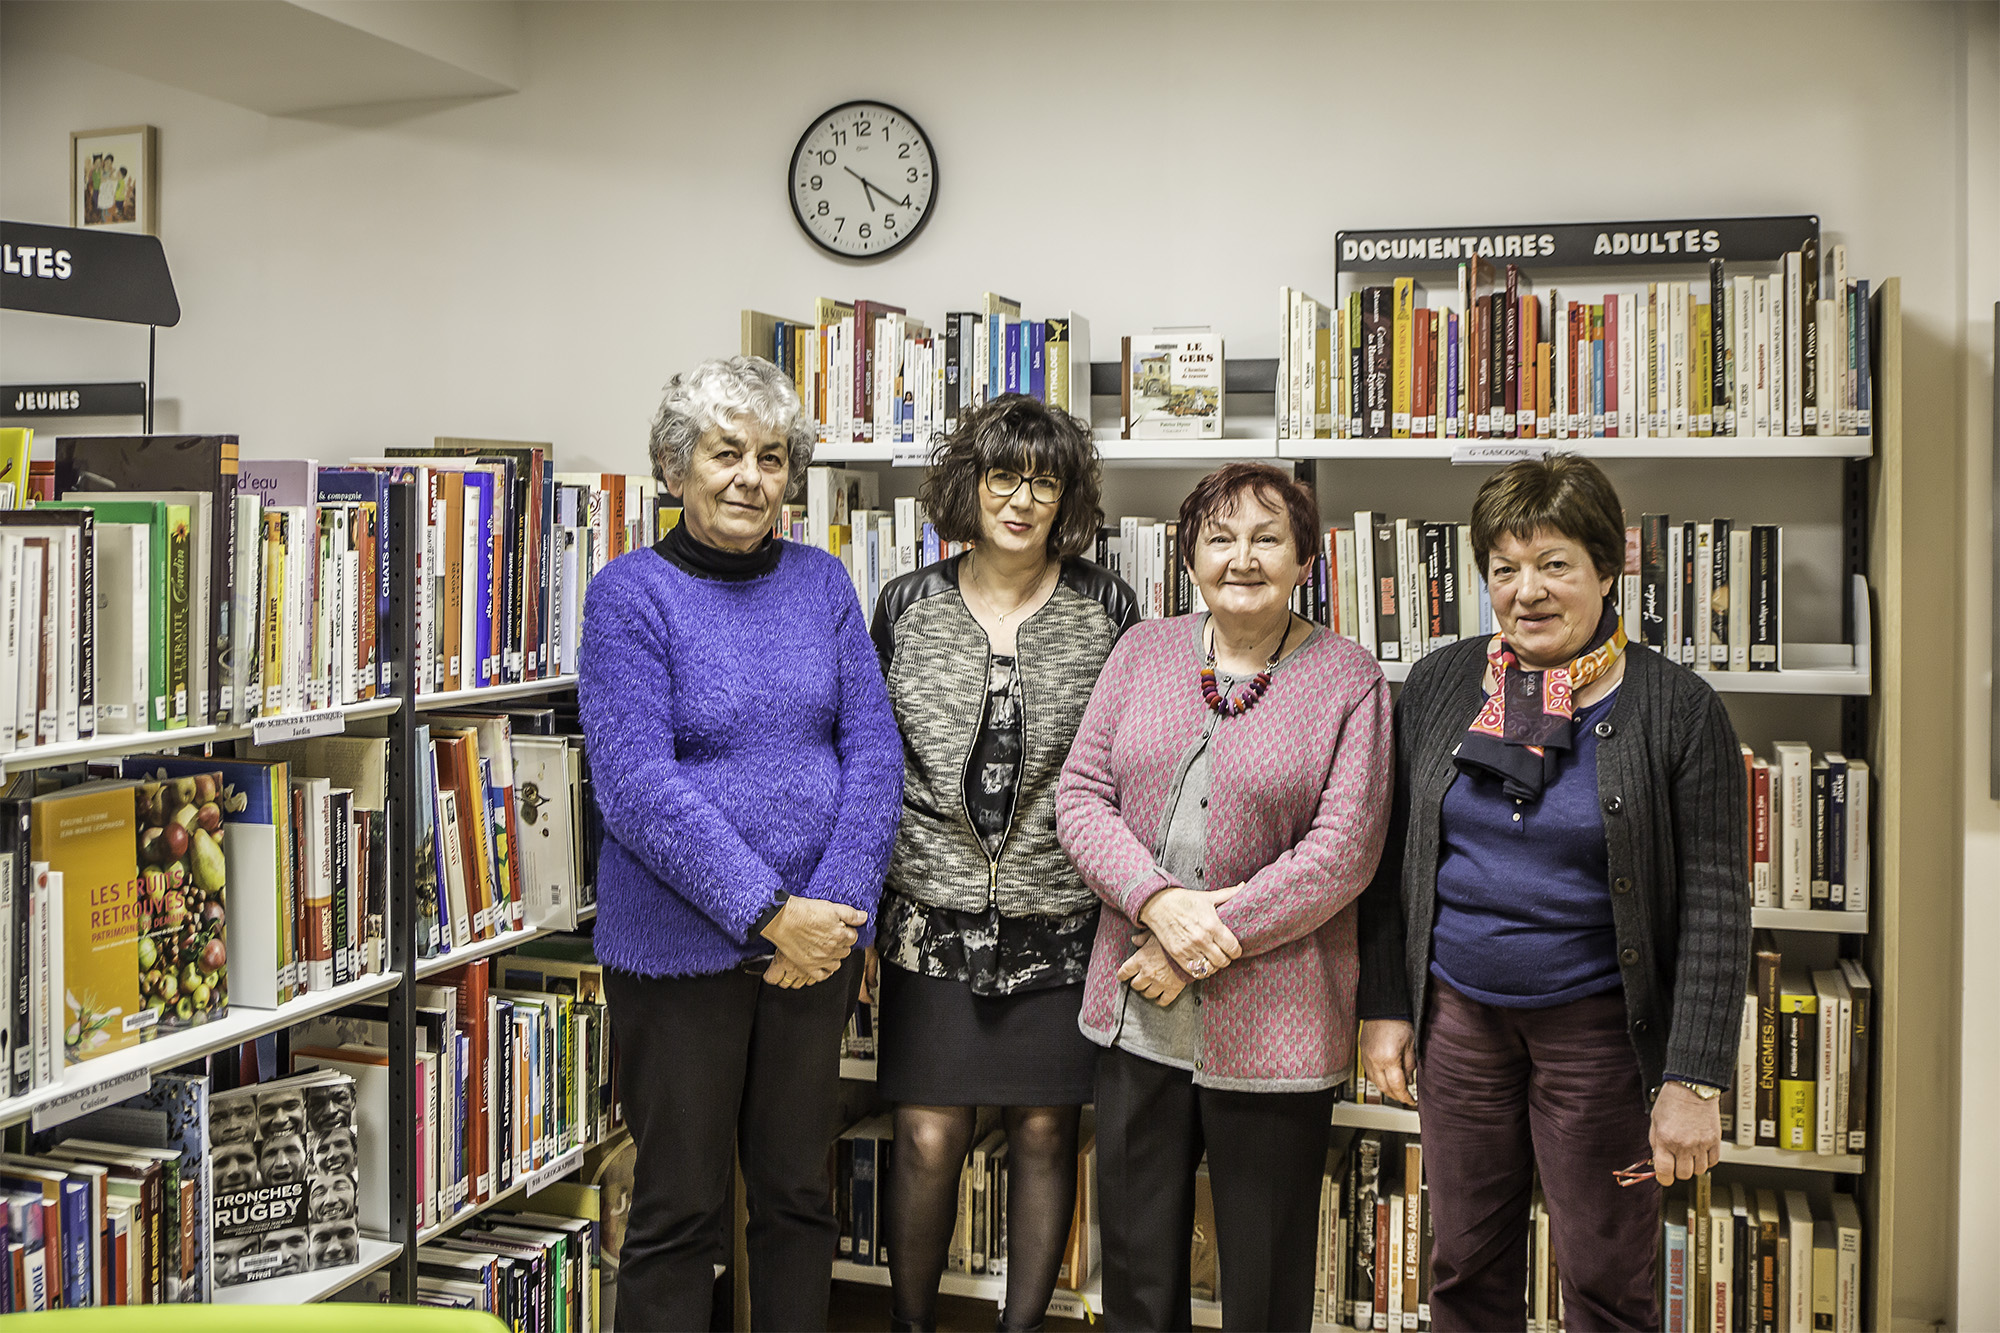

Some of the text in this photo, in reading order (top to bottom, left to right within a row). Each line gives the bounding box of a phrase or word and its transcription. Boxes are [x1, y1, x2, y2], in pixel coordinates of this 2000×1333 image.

[832, 131, 846, 146] 11
[852, 121, 871, 137] 12
[882, 126, 889, 141] 1
[816, 150, 837, 166] 10
[898, 143, 910, 159] 2
[810, 175, 823, 191] 9
[906, 168, 918, 183] 3
[817, 200, 829, 216] 8
[900, 194, 912, 210] 4
[834, 218, 845, 233] 7
[859, 223, 871, 238] 6
[884, 214, 895, 229] 5
[1342, 228, 1722, 263] DOCUMENTAIRES ADULTES
[0, 243, 73, 281] LTES
[1179, 353, 1214, 363] GERS
[1187, 343, 1202, 352] LE
[1008, 352, 1017, 389] Bouddhisme
[1050, 346, 1059, 406] MYTHOLOGIE
[15, 390, 81, 412] JEUNES
[1398, 404, 1406, 413] ES
[1482, 449, 1531, 457] GASCOGNE
[238, 471, 277, 489] d'eau
[327, 491, 362, 501] compagnie
[554, 530, 562, 587] MAISONS
[170, 550, 187, 602] Jardin
[1381, 577, 1396, 615] DUPLEIX
[552, 618, 560, 646] ÂME
[1698, 616, 1707, 646] LAURENT
[91, 870, 183, 907] LES FRUITS
[91, 889, 184, 930] RETROUVÉS
[336, 888, 347, 948] BIG DATA
[91, 924, 138, 944] PATRIMOINE
[154, 912, 184, 928] DEMAIN
[1790, 1018, 1799, 1038] France
[1759, 1025, 1775, 1089] ÉNIGMES
[214, 1183, 302, 1208] TRONCHES
[215, 1197, 302, 1229] RUGBY
[1406, 1194, 1418, 1279] LE PARIS ARABE
[151, 1214, 159, 1284] de mouches
[33, 1266, 44, 1302] VOILE
